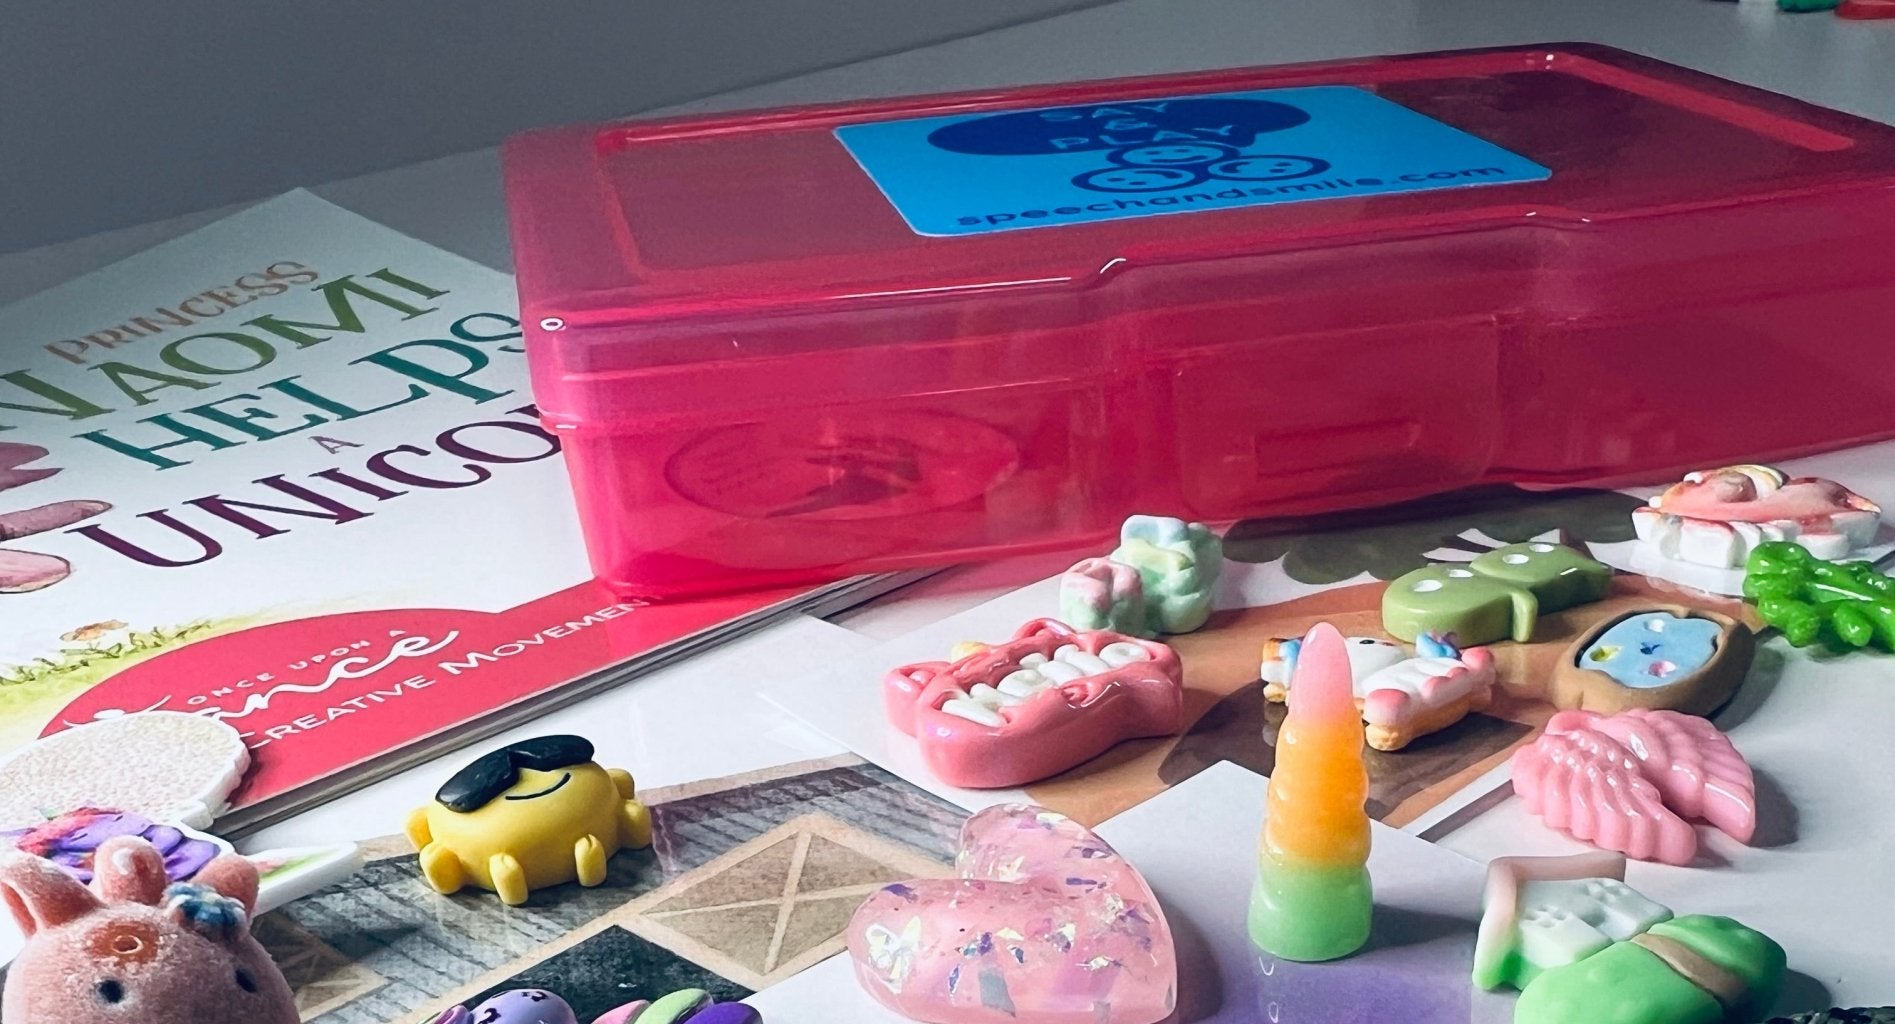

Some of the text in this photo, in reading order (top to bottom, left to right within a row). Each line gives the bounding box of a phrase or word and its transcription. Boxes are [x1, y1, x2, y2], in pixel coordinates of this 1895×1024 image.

[1050, 124, 1237, 149] PLAY
[956, 165, 1506, 228] speechandsmile.com
[43, 261, 319, 365] PRINCESS
[0, 267, 450, 431] NAOMI
[307, 435, 364, 454] A
[64, 403, 562, 567] UNICO
[187, 672, 275, 705] ONCE
[289, 640, 370, 670] UPON
